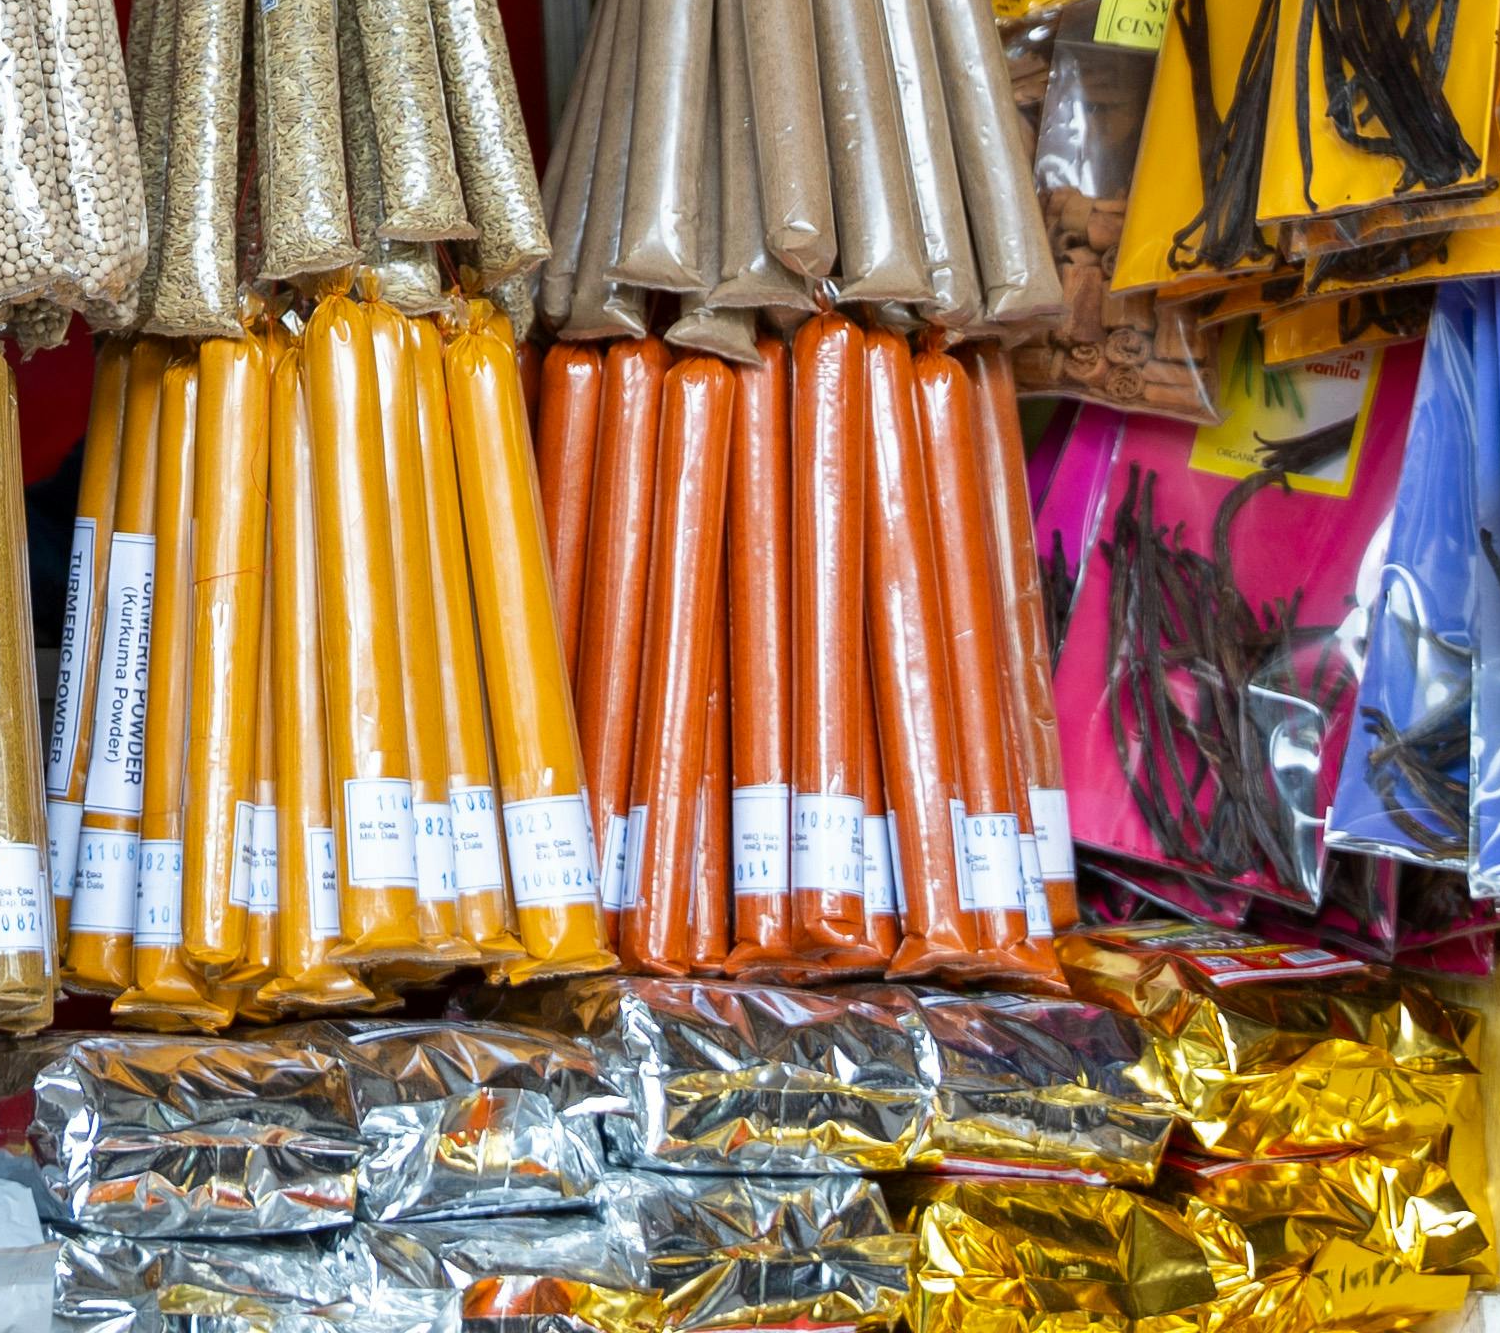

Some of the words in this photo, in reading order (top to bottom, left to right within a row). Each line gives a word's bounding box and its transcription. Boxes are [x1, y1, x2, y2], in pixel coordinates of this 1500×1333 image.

[61, 550, 83, 663] TURMERIC
[115, 586, 138, 679] (Kurkuma
[49, 668, 72, 764] POWDER
[104, 686, 127, 764] Powder)
